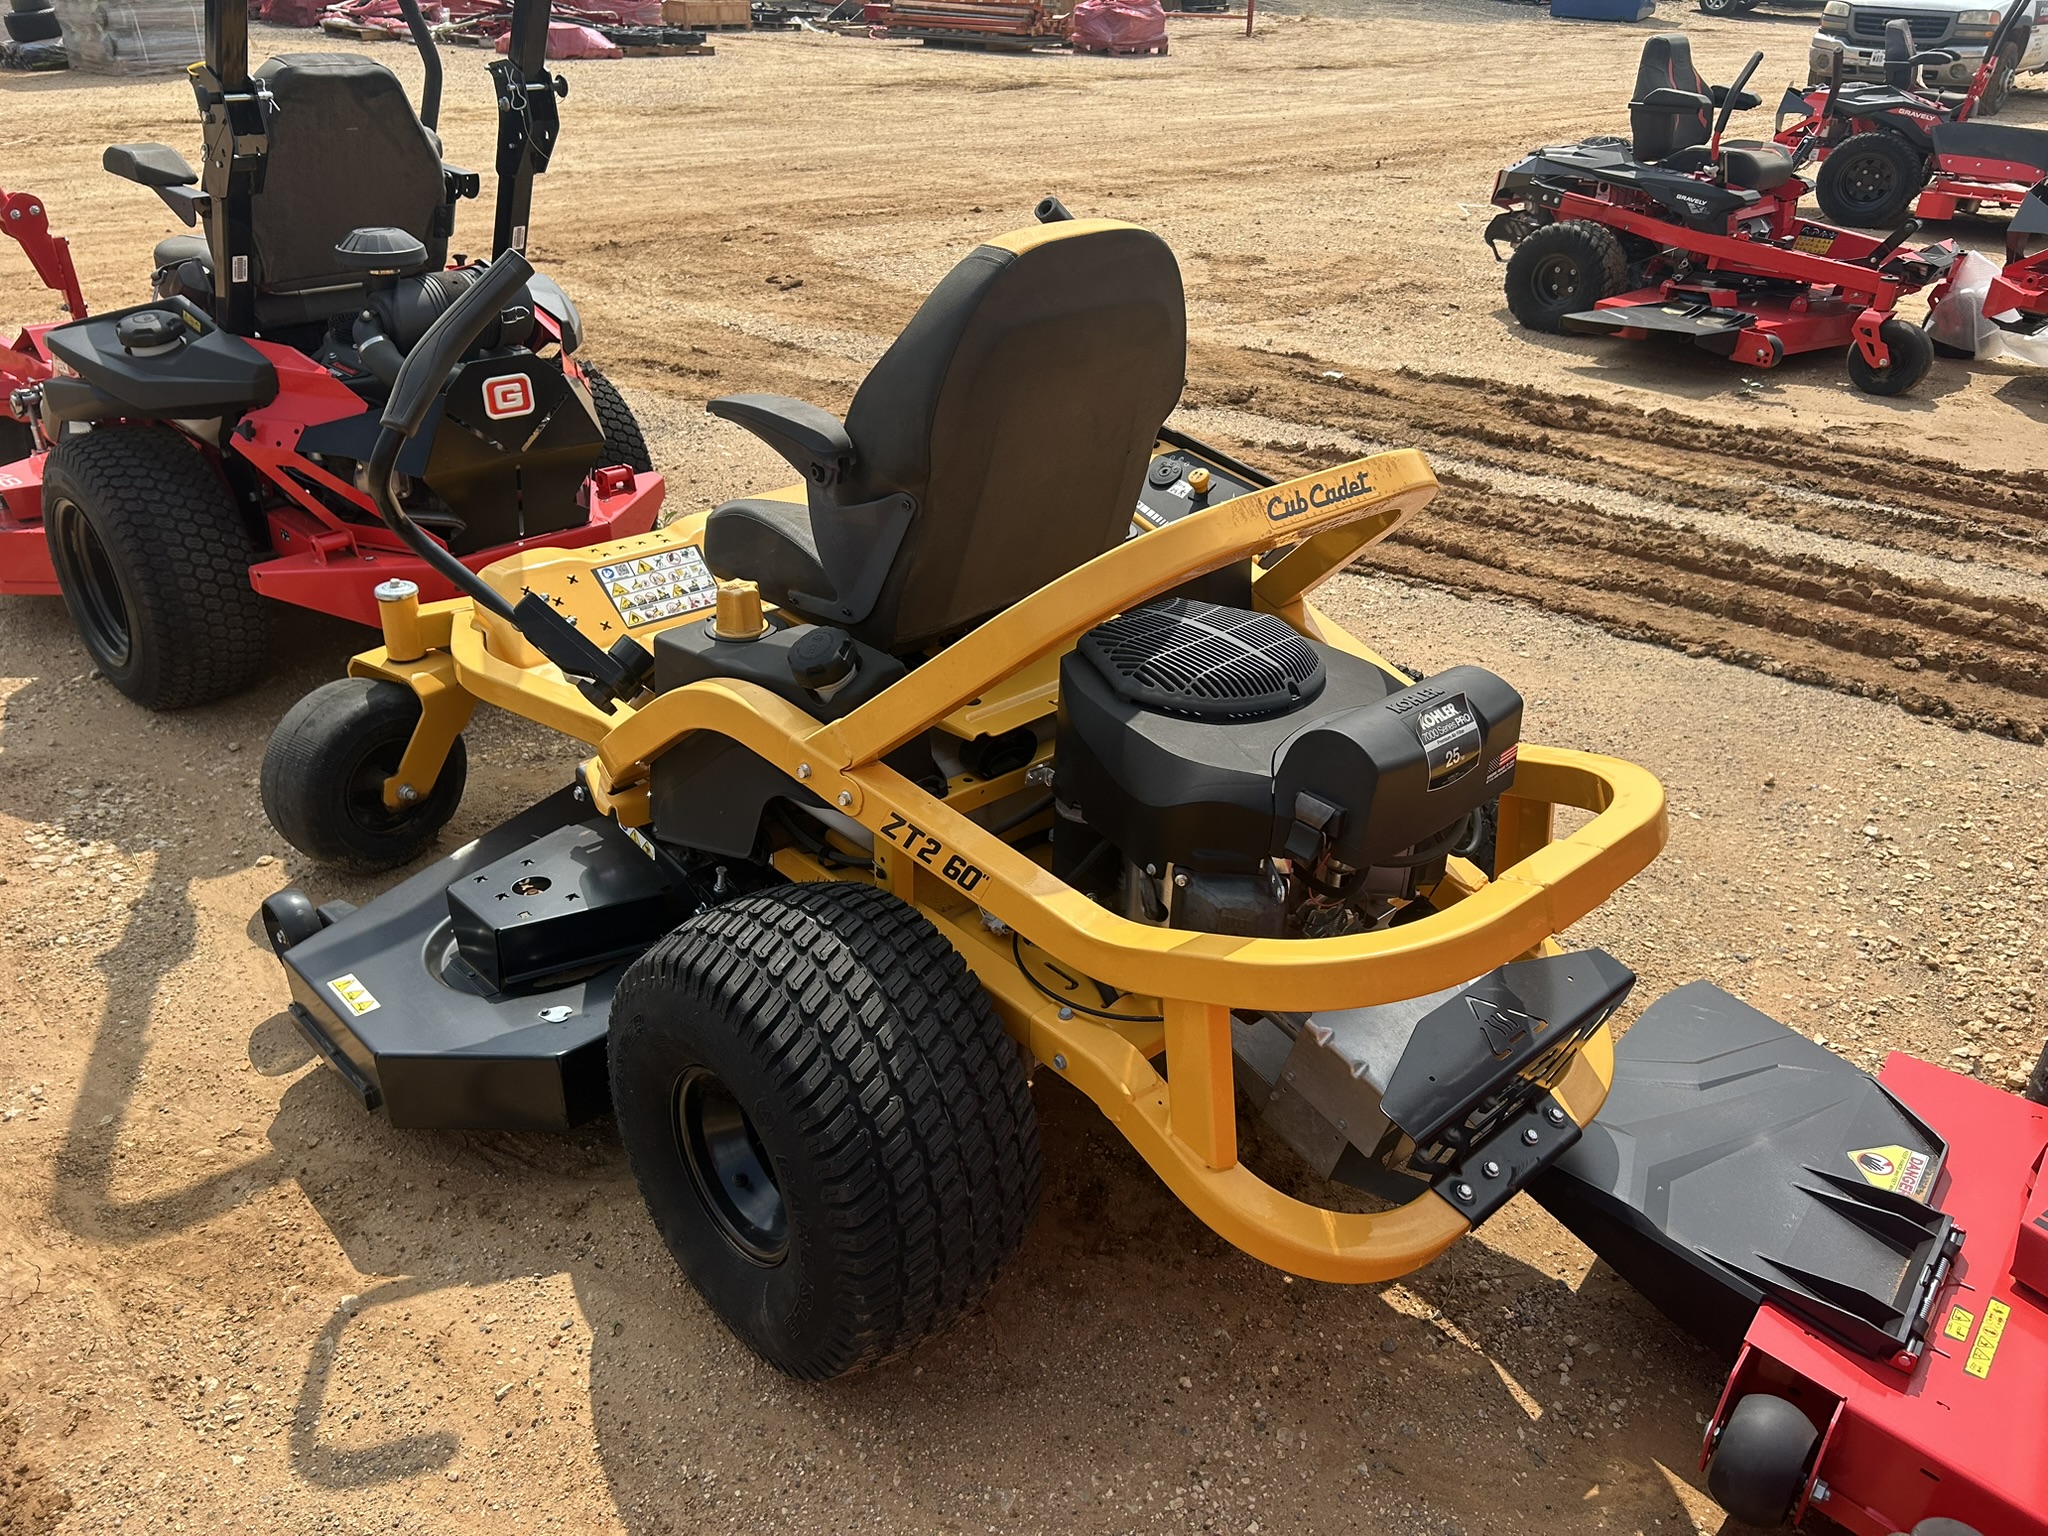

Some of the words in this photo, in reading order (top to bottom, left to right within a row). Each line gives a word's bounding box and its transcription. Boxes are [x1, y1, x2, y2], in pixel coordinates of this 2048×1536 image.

[1898, 108, 1936, 121] GRAVELY
[1675, 193, 1708, 206] GRAVELY
[1267, 490, 1309, 522] Cub
[1309, 471, 1373, 508] Cadet
[1386, 687, 1447, 715] KOHLER
[1420, 702, 1460, 730] KOHLER
[1422, 729, 1440, 743] 7000
[1437, 721, 1458, 735] Series
[1454, 713, 1471, 727] PRO
[1445, 746, 1461, 769] 25
[880, 811, 942, 865] ZT2
[942, 854, 990, 892] 60"
